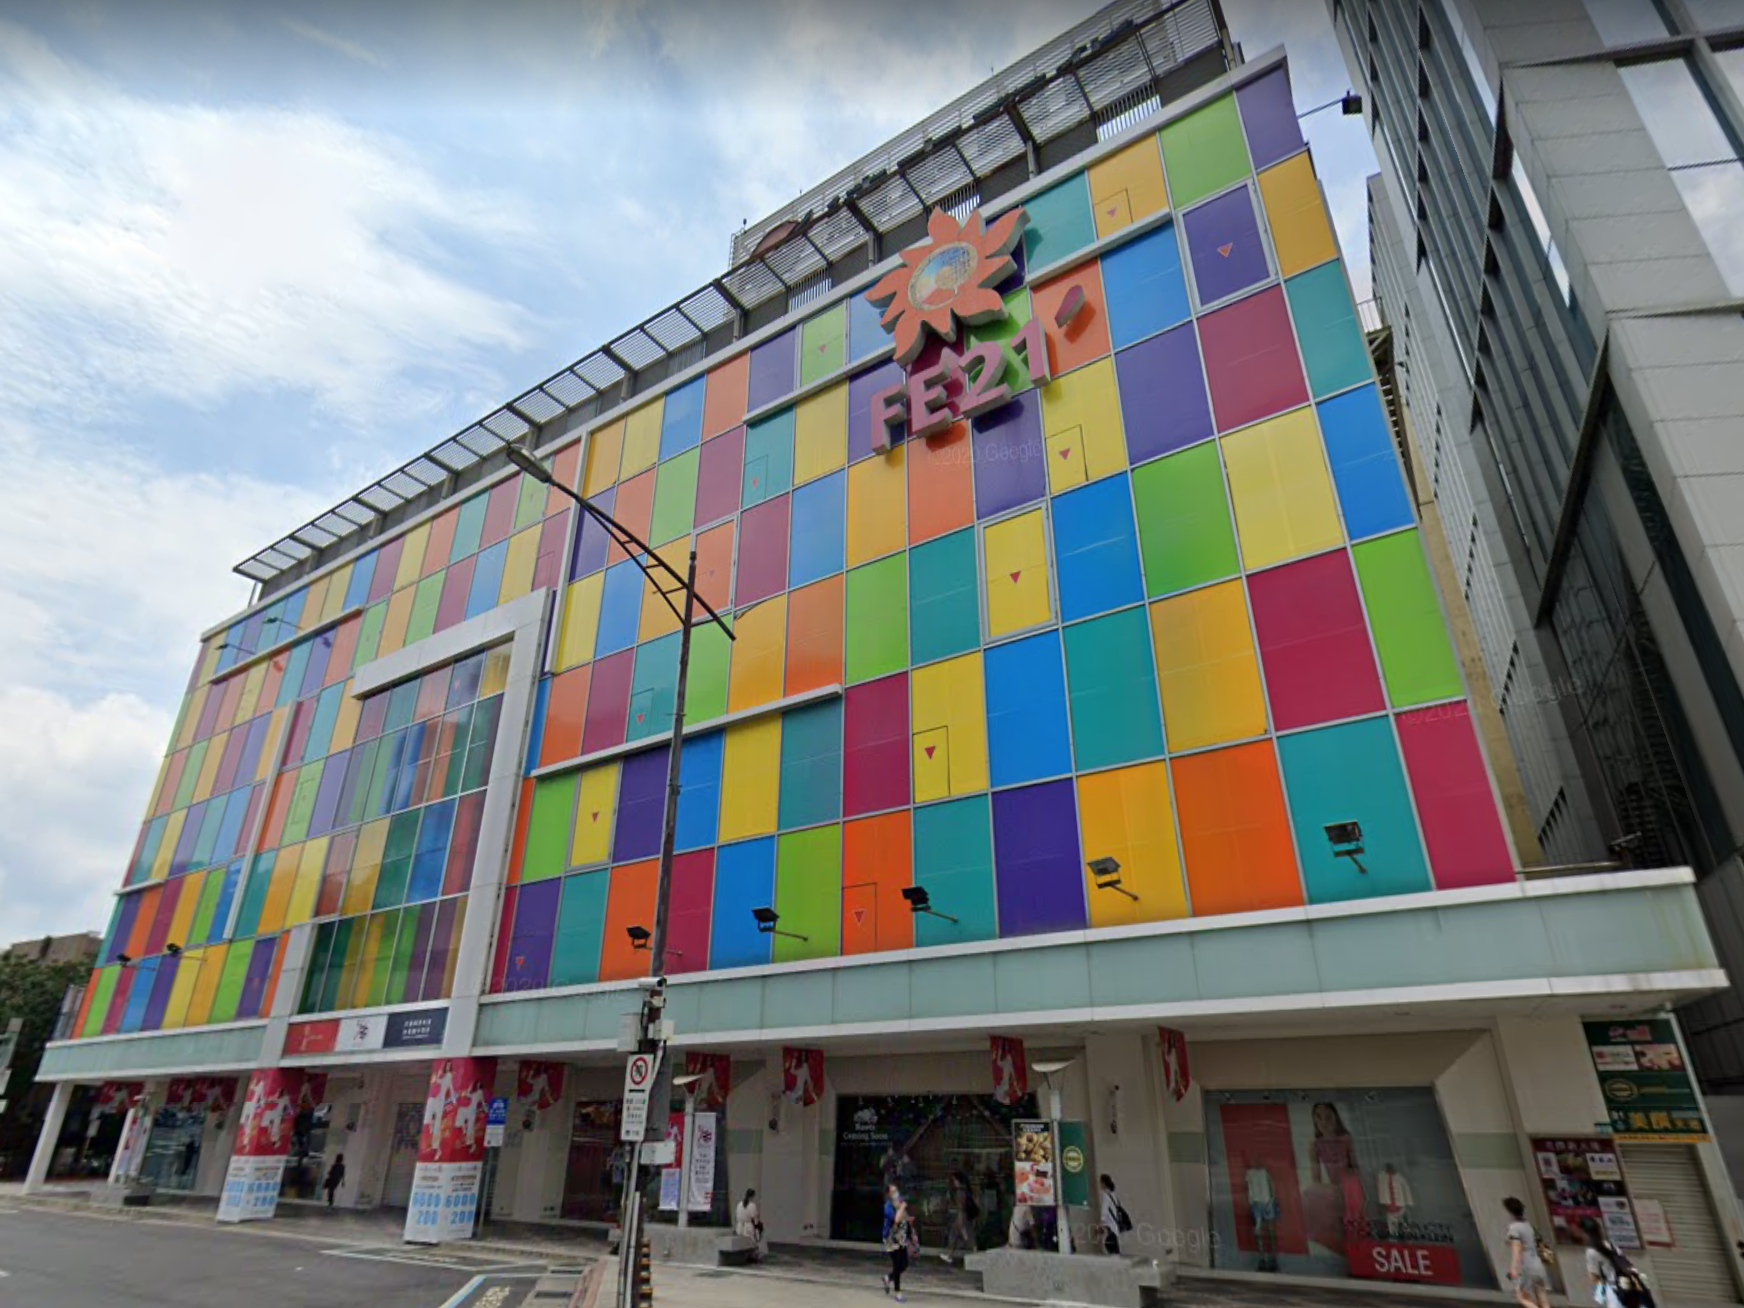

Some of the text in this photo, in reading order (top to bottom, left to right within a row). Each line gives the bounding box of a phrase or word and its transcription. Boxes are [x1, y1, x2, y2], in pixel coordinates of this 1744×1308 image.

[843, 1132, 888, 1140] Coming Soon
[1372, 1246, 1434, 1276] SALE
